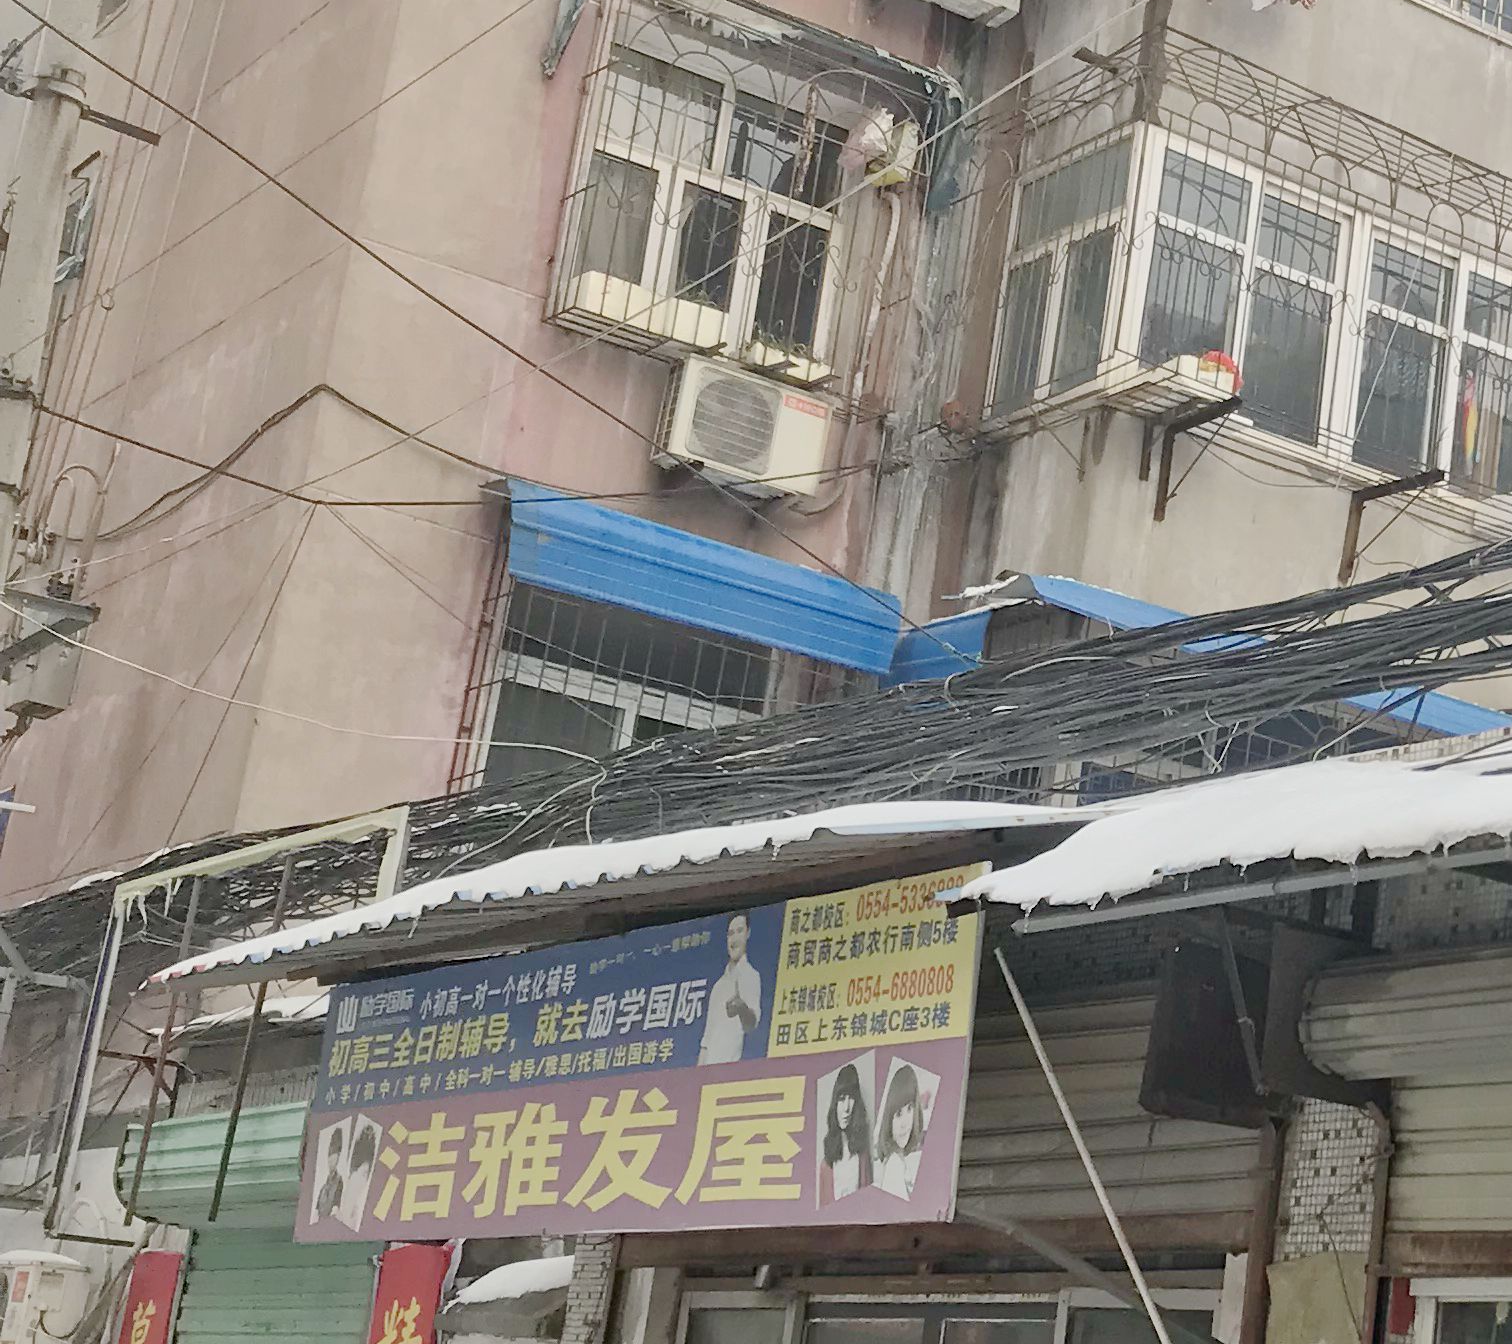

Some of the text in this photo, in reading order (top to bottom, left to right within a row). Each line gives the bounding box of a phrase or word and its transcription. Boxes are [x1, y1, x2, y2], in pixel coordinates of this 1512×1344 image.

[846, 964, 954, 1007] 0554-6880808
[373, 1074, 807, 1223] 洁雅发屋
